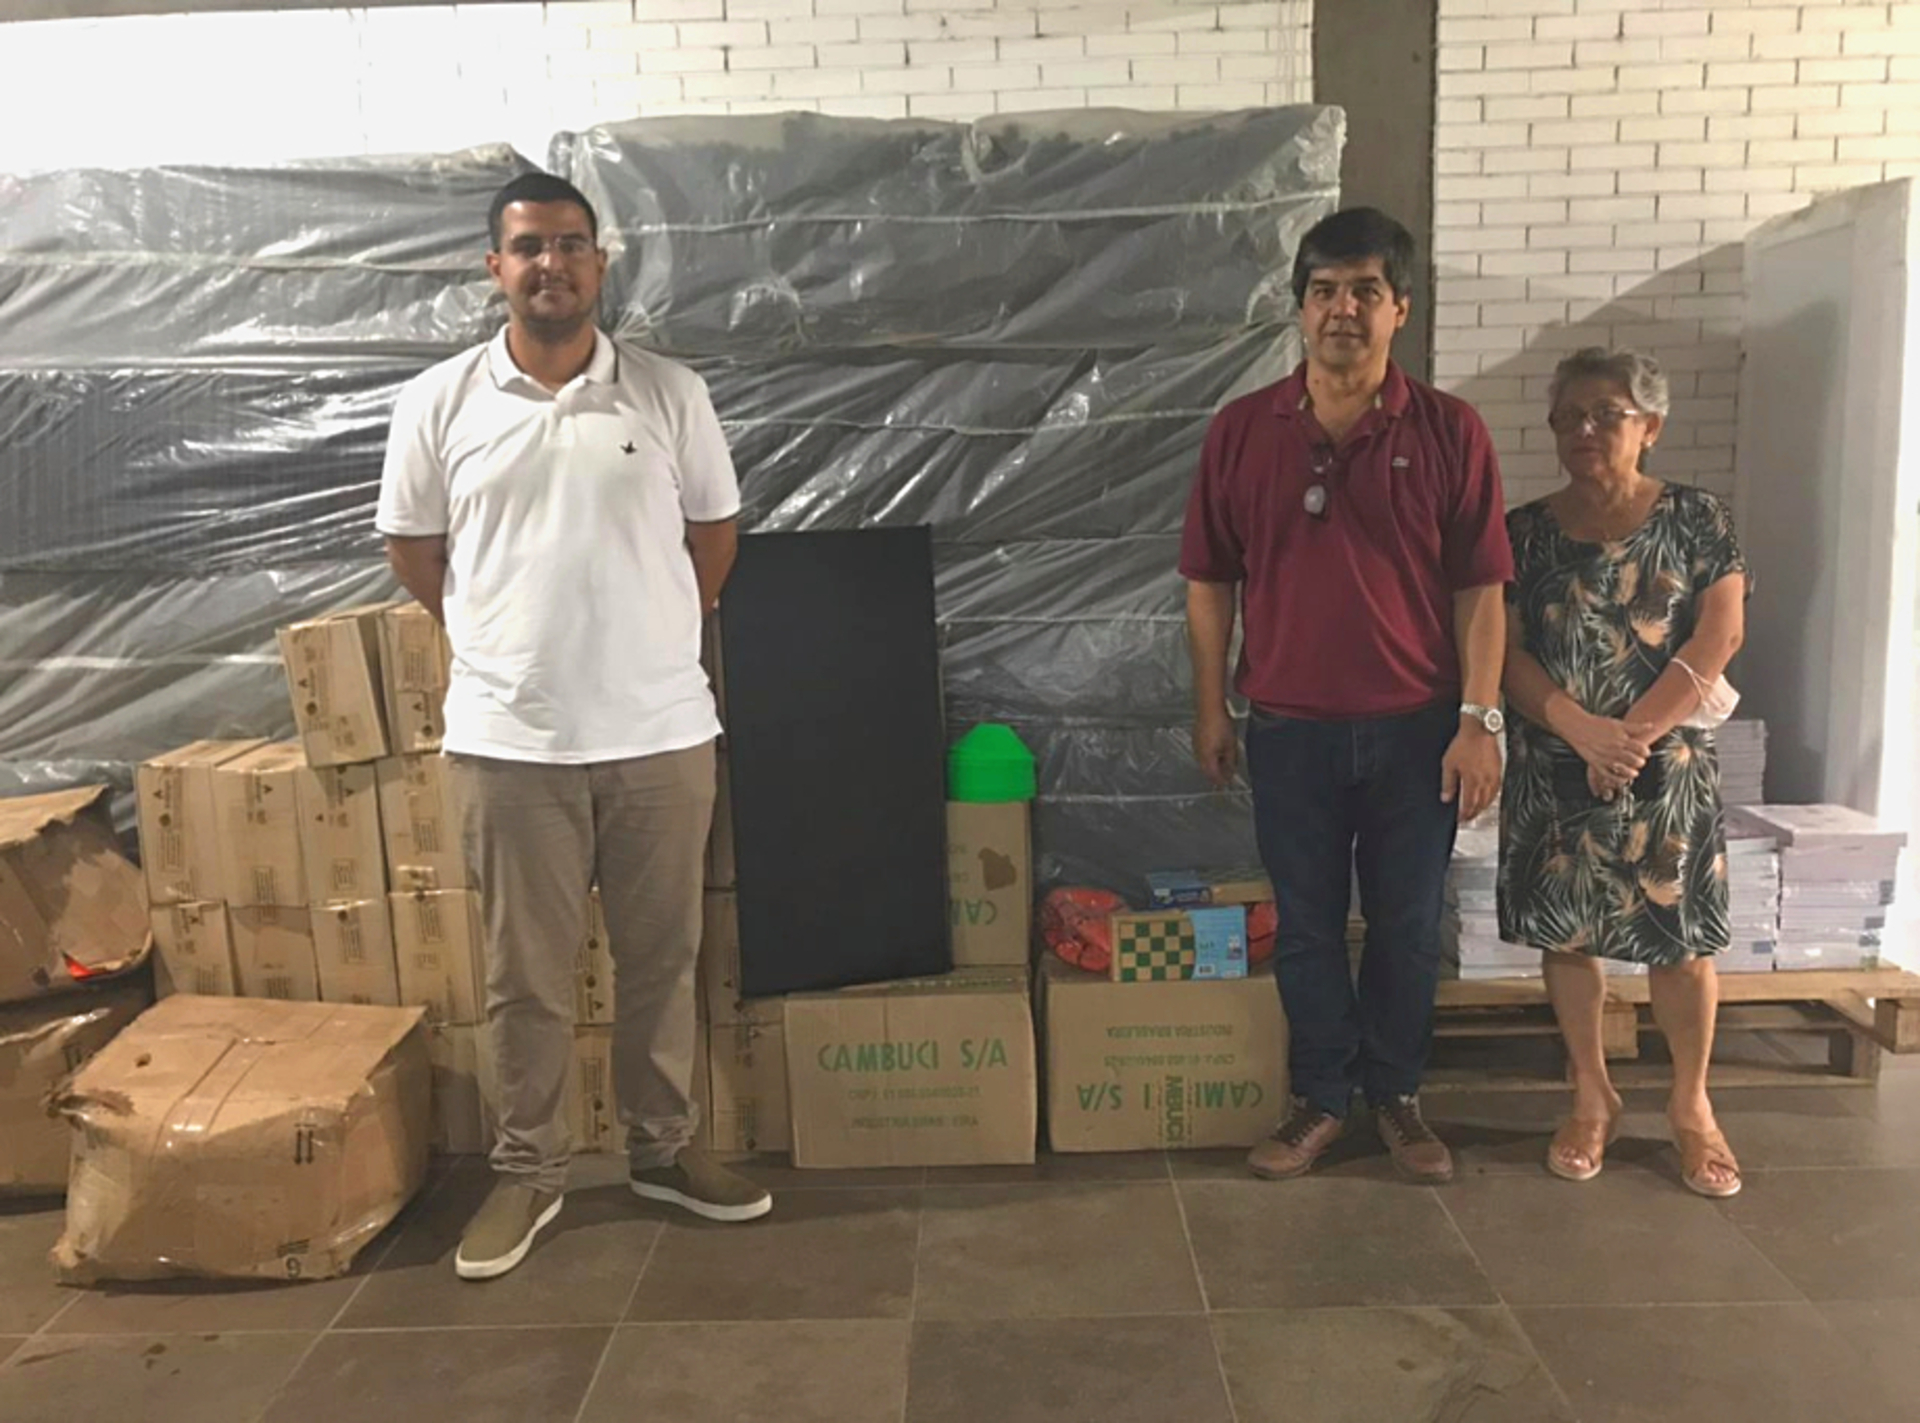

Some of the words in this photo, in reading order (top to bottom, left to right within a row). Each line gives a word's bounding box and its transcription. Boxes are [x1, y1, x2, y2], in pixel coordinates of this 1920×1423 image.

[817, 1039, 939, 1073] CAMBUCI
[960, 1037, 1008, 1072] S/A
[1076, 1082, 1122, 1112] S/A
